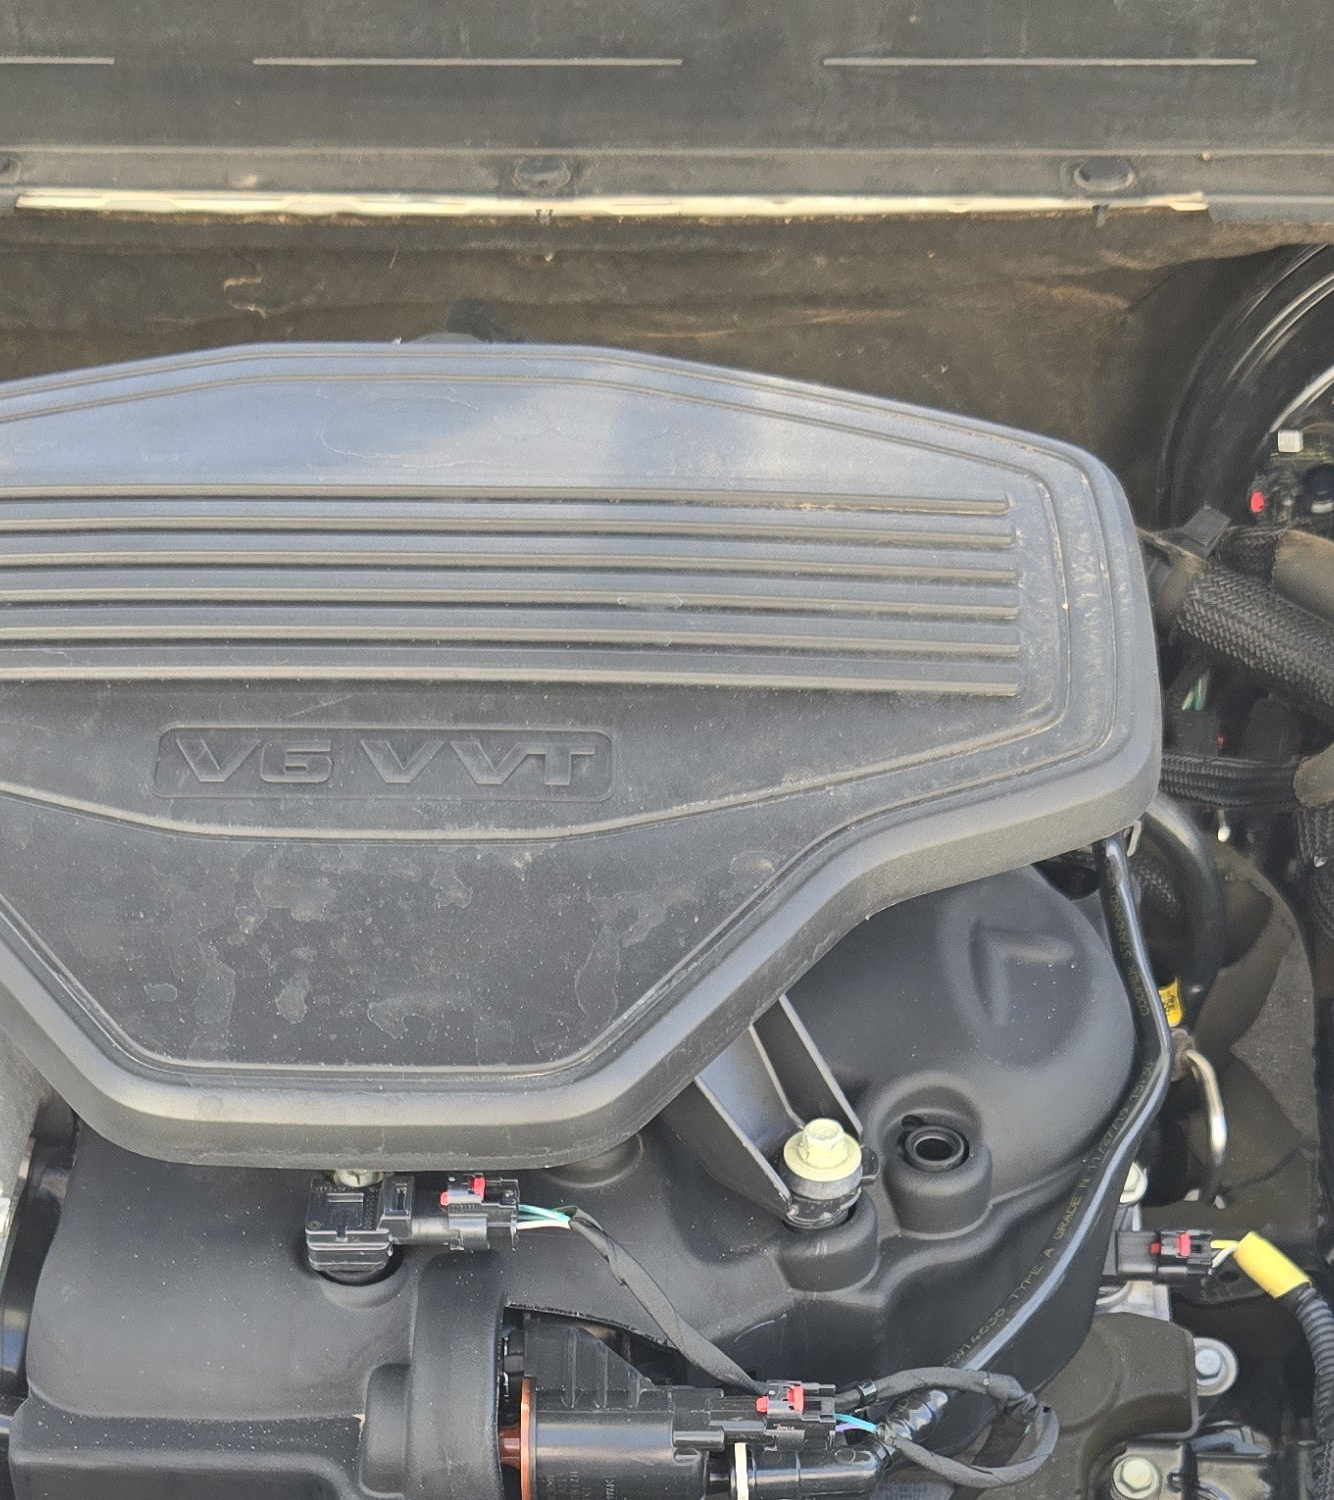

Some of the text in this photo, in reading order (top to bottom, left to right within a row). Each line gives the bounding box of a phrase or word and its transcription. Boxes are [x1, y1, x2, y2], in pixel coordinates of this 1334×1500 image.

[176, 738, 596, 786] V6 VVT
[1011, 1263, 1043, 1301] TYPE
[1042, 1244, 1055, 1258] A
[1053, 1196, 1081, 1240] GRADE
[1078, 1177, 1091, 1190] N
